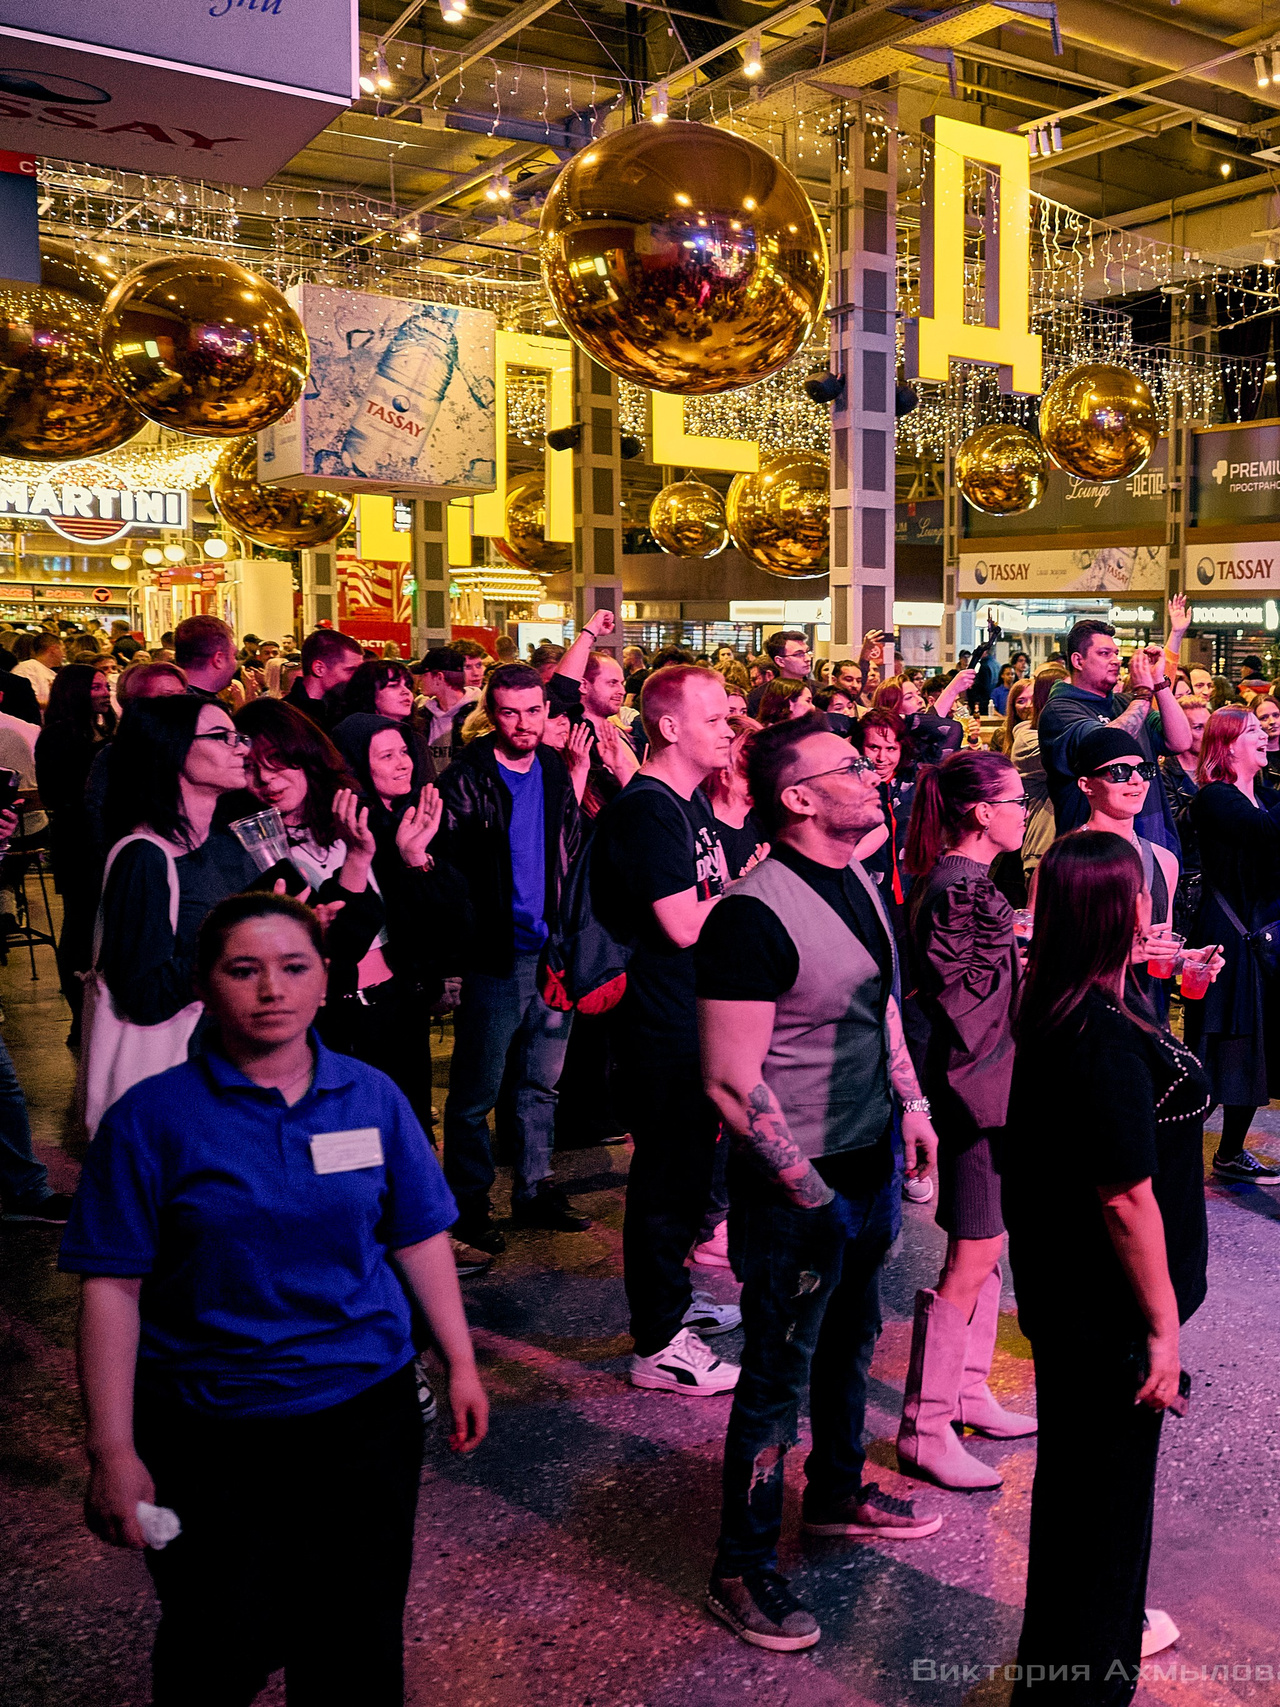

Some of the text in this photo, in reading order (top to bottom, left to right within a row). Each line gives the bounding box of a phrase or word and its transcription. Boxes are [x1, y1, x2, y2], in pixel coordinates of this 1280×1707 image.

[366, 399, 426, 438] TASSAY
[0, 481, 179, 524] MARTINI
[916, 517, 944, 544] Loung
[989, 563, 1031, 581] TASSAY
[1217, 559, 1275, 580] TASSAY
